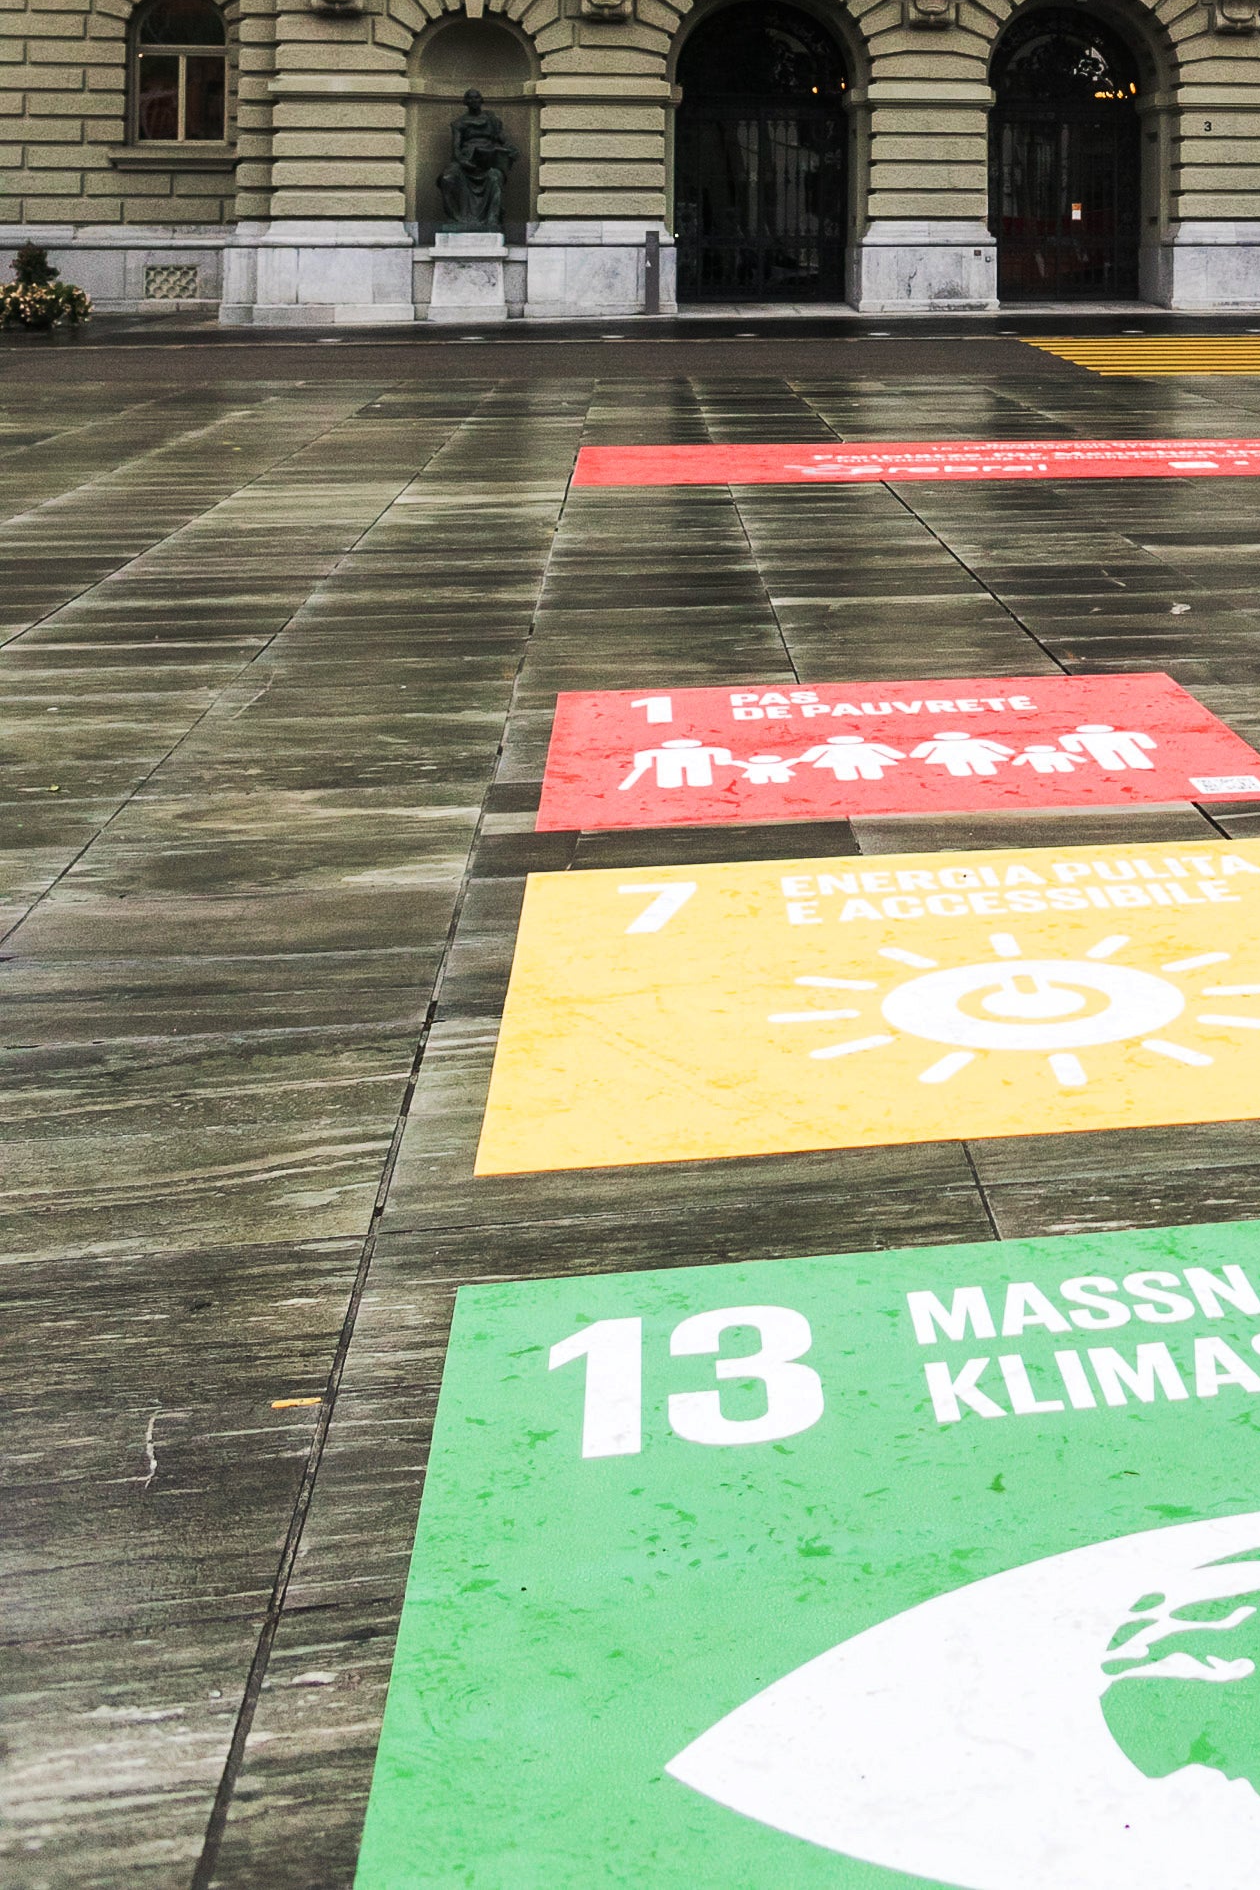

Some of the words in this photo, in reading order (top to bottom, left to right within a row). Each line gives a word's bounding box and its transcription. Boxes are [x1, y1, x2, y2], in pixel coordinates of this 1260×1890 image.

[1203, 121, 1213, 132] 3
[630, 696, 673, 724] 1
[730, 690, 819, 707] PAS
[733, 705, 793, 721] DE
[781, 863, 1048, 899] ENERGIA
[617, 881, 699, 935] 7
[787, 901, 824, 926] E
[838, 879, 1244, 923] ACCESSIBILE
[548, 1304, 825, 1460] 13
